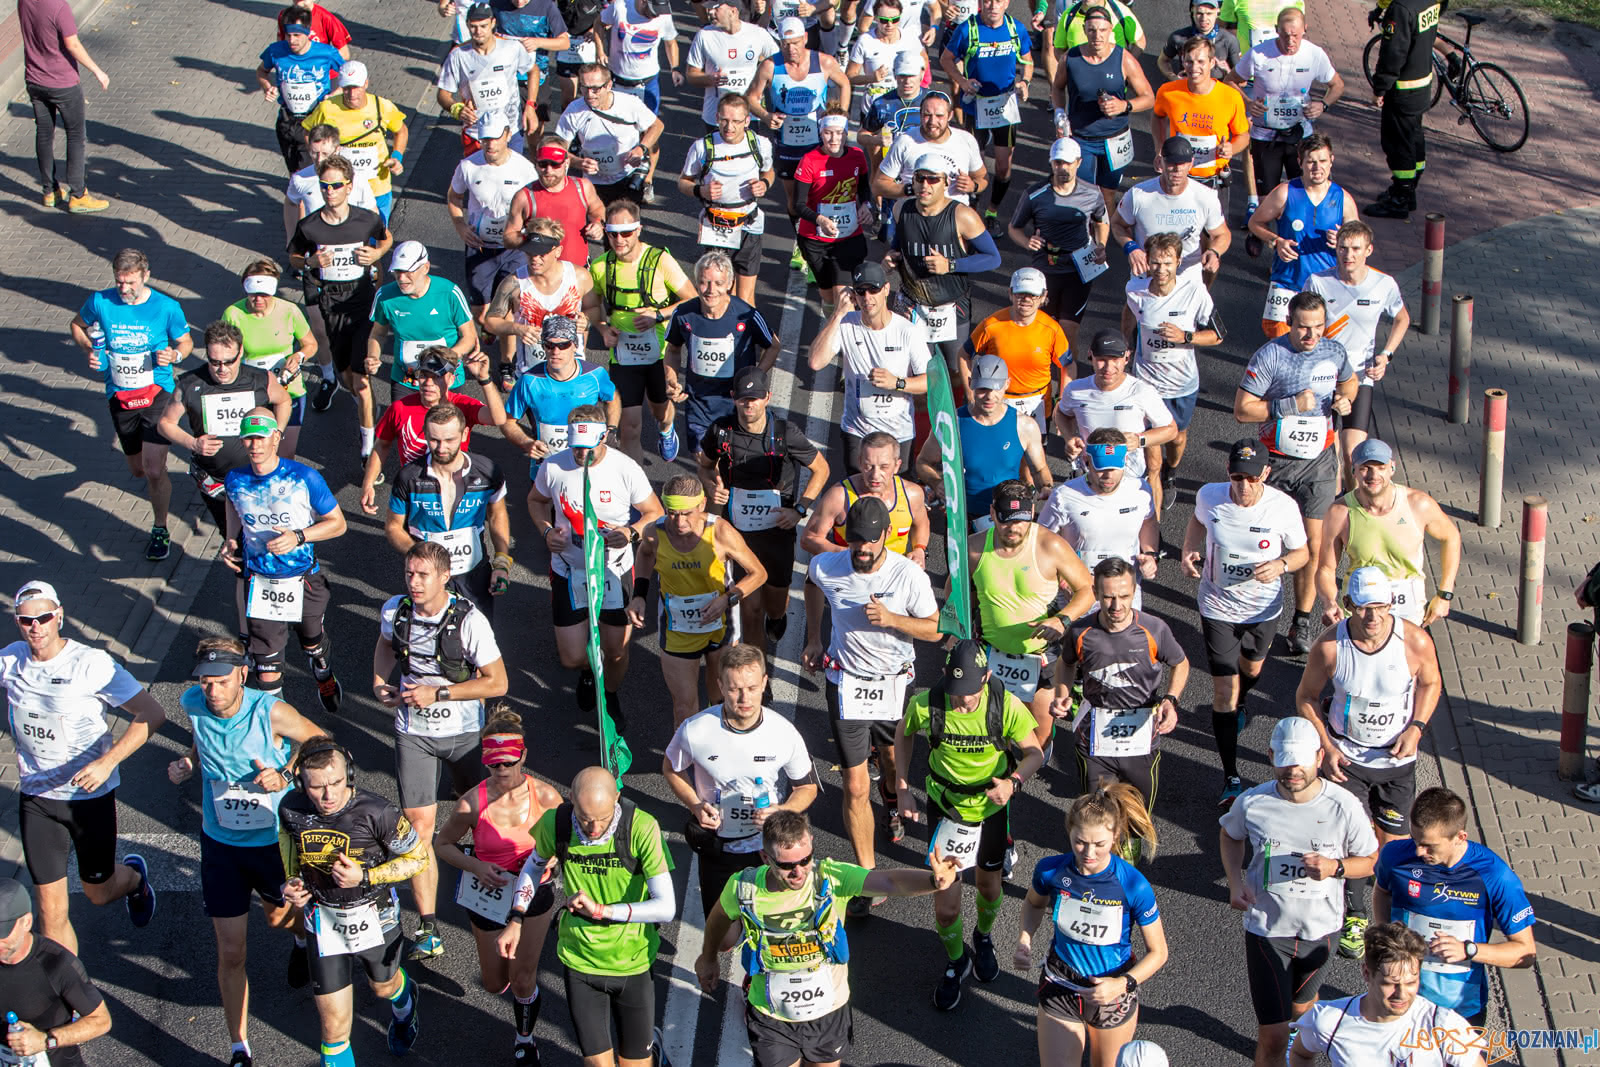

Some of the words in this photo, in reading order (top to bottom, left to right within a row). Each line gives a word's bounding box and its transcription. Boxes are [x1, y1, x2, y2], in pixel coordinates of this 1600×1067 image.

[287, 92, 312, 101] 3448
[478, 88, 502, 98] 3766
[787, 96, 808, 104] POWER
[1273, 107, 1298, 117] 5583
[788, 126, 811, 134] 2374
[352, 158, 372, 168] 499
[1155, 214, 1198, 226] TEAM
[925, 317, 947, 328] 1387
[624, 342, 652, 352] 1245
[697, 350, 727, 361] 2608
[116, 365, 145, 375] 2056
[873, 393, 893, 403] 716
[216, 407, 246, 420] 5166
[1288, 430, 1318, 442] 4375
[741, 504, 772, 515] 3797
[258, 512, 291, 525] QSG
[1221, 563, 1253, 578] 1959
[261, 589, 295, 603] 5086
[995, 663, 1030, 682] 3760
[854, 687, 884, 701] 2161
[414, 704, 451, 719] 2360
[1357, 712, 1395, 727] 3407
[23, 724, 56, 741] 5184
[1110, 725, 1137, 739] 837
[956, 746, 985, 754] TEAM
[223, 798, 260, 811] 3799
[945, 838, 977, 854] 5661
[580, 865, 608, 877] TEAM
[332, 920, 369, 936] 4786
[1070, 920, 1108, 938] 4217
[781, 986, 825, 1003] 2904
